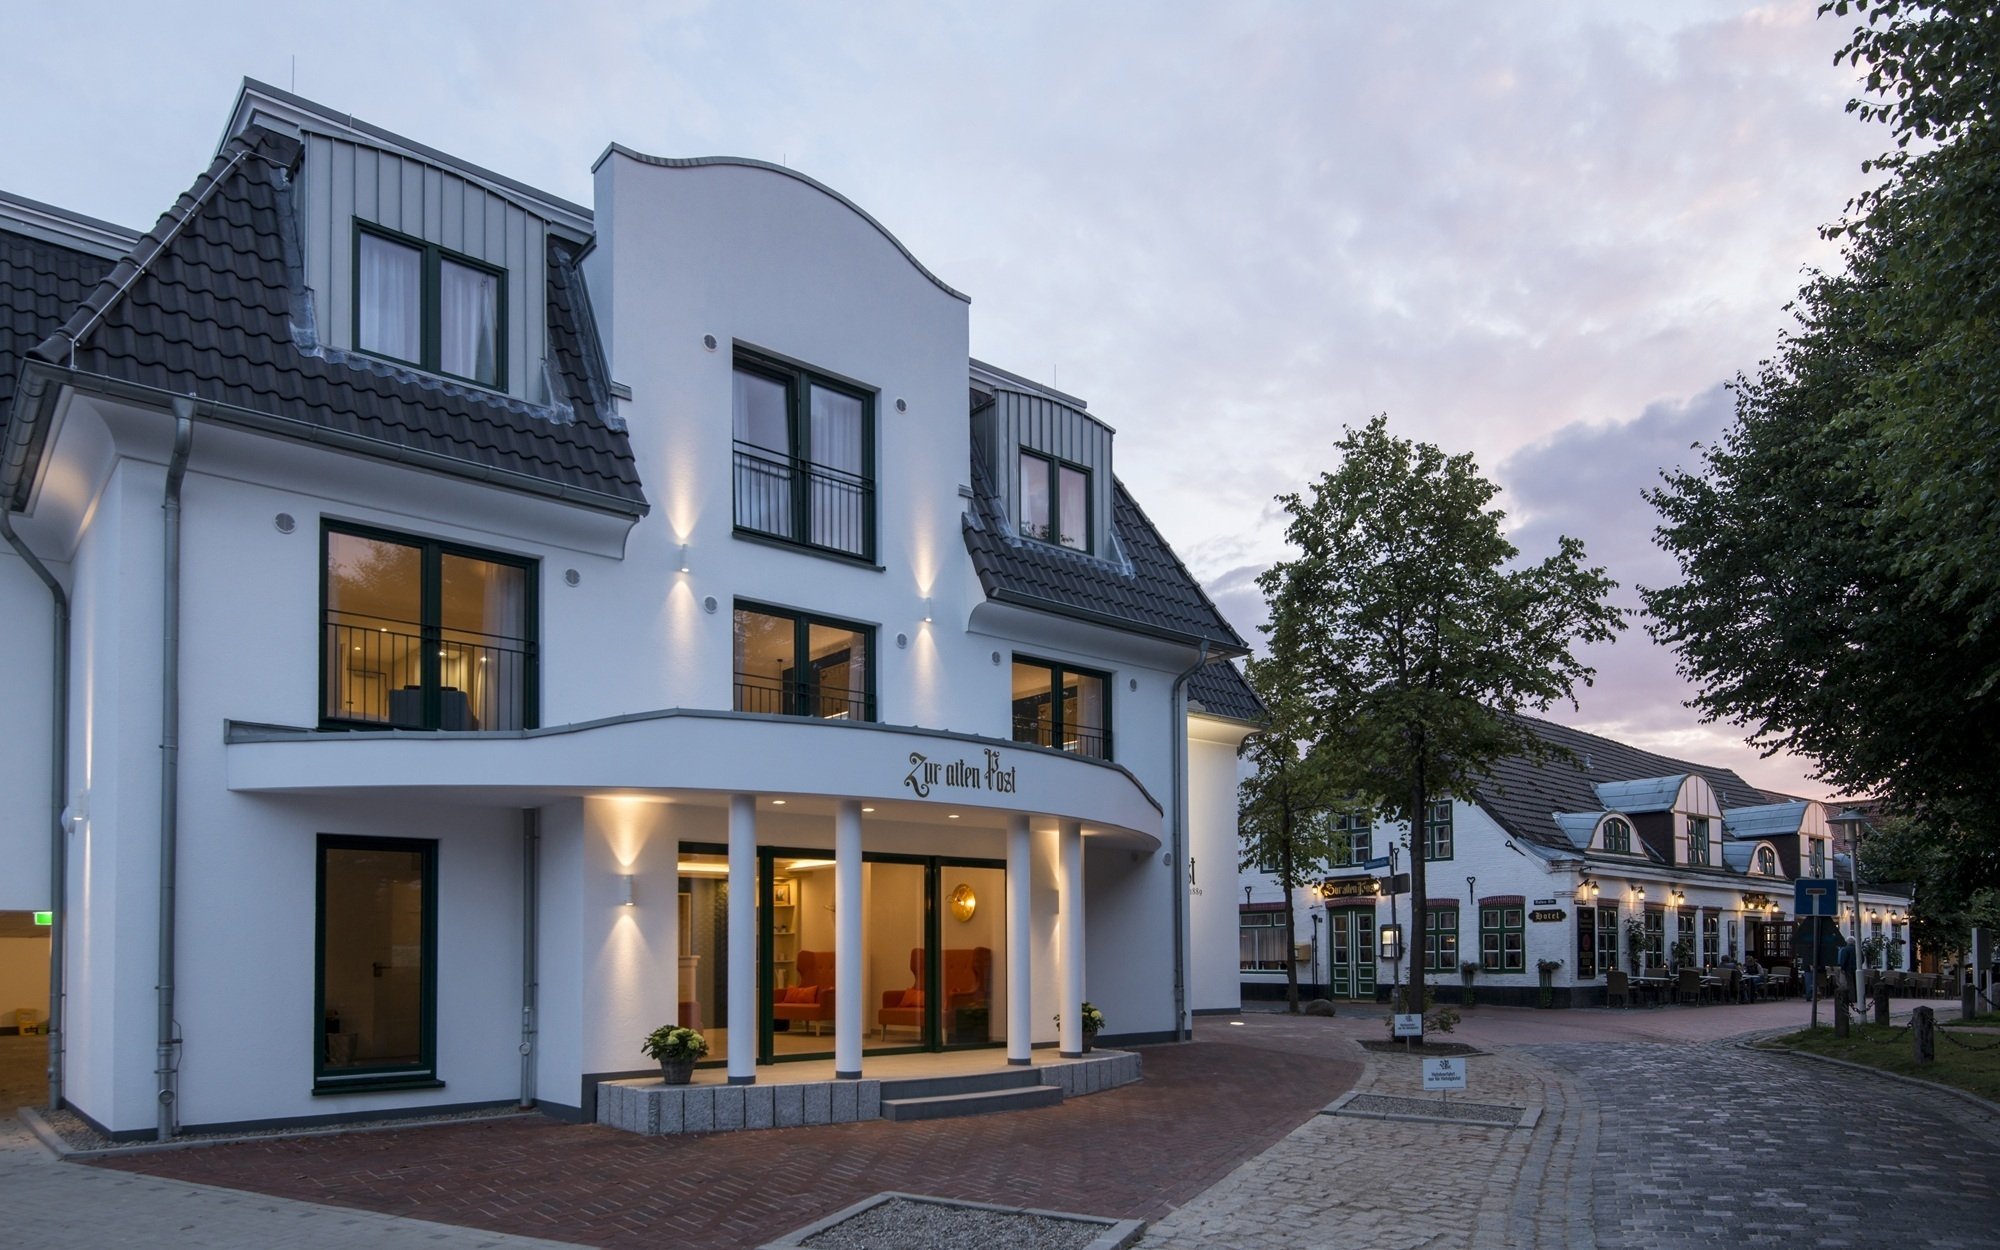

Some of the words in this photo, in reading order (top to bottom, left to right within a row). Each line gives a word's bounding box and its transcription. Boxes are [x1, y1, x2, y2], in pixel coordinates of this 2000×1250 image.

[904, 752, 942, 798] Zur
[946, 759, 981, 789] alten
[984, 748, 1016, 794] Post
[1535, 911, 1560, 920] Hotel
